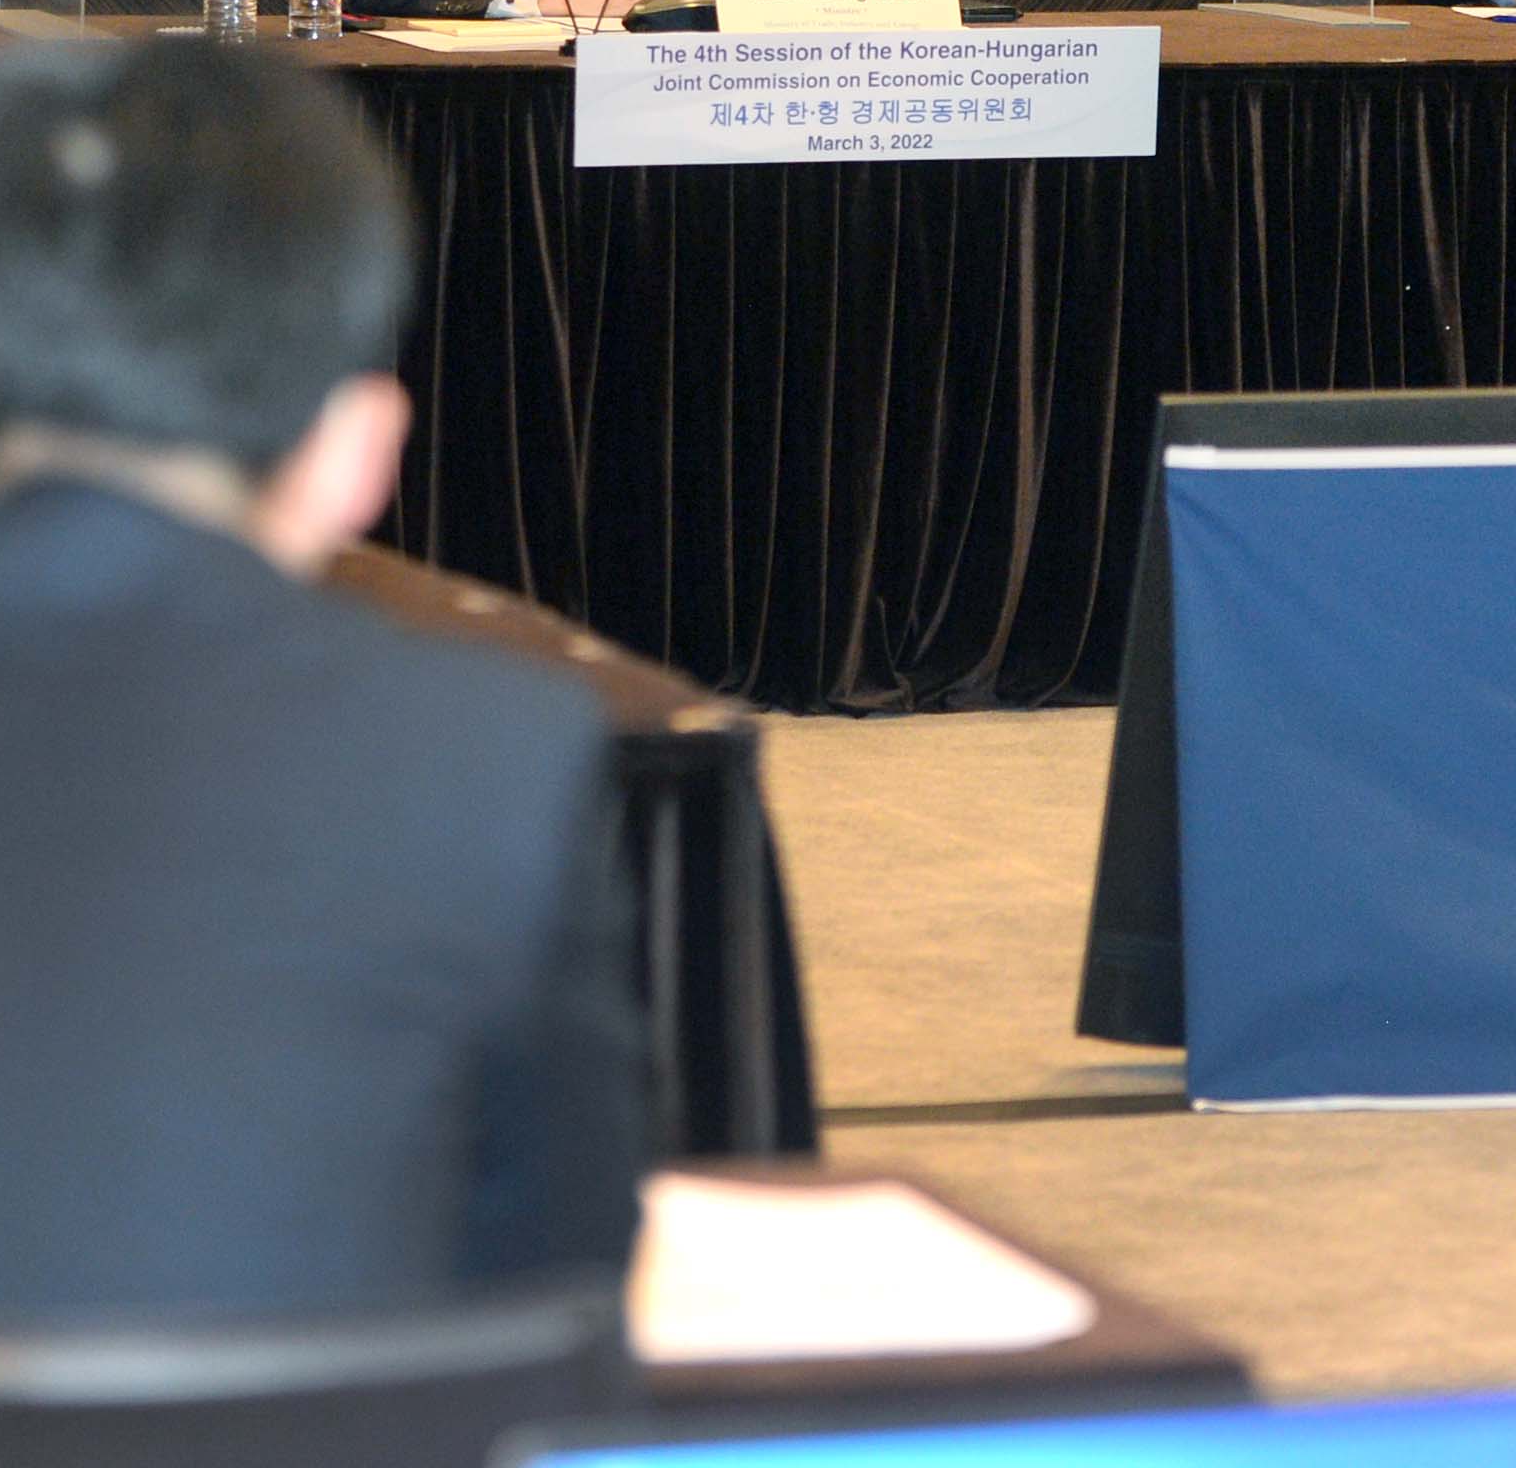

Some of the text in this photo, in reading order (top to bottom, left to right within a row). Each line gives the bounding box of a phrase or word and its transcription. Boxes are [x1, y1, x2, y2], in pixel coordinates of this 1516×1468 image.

[647, 39, 1097, 63] The 4th Session of the Korean-Hungarian
[654, 69, 1089, 91] Joint Commission on Economic Cooperation
[711, 98, 1031, 126] 제4차 한·헝 경제공동위원회
[808, 134, 932, 150] March 3, 2022
